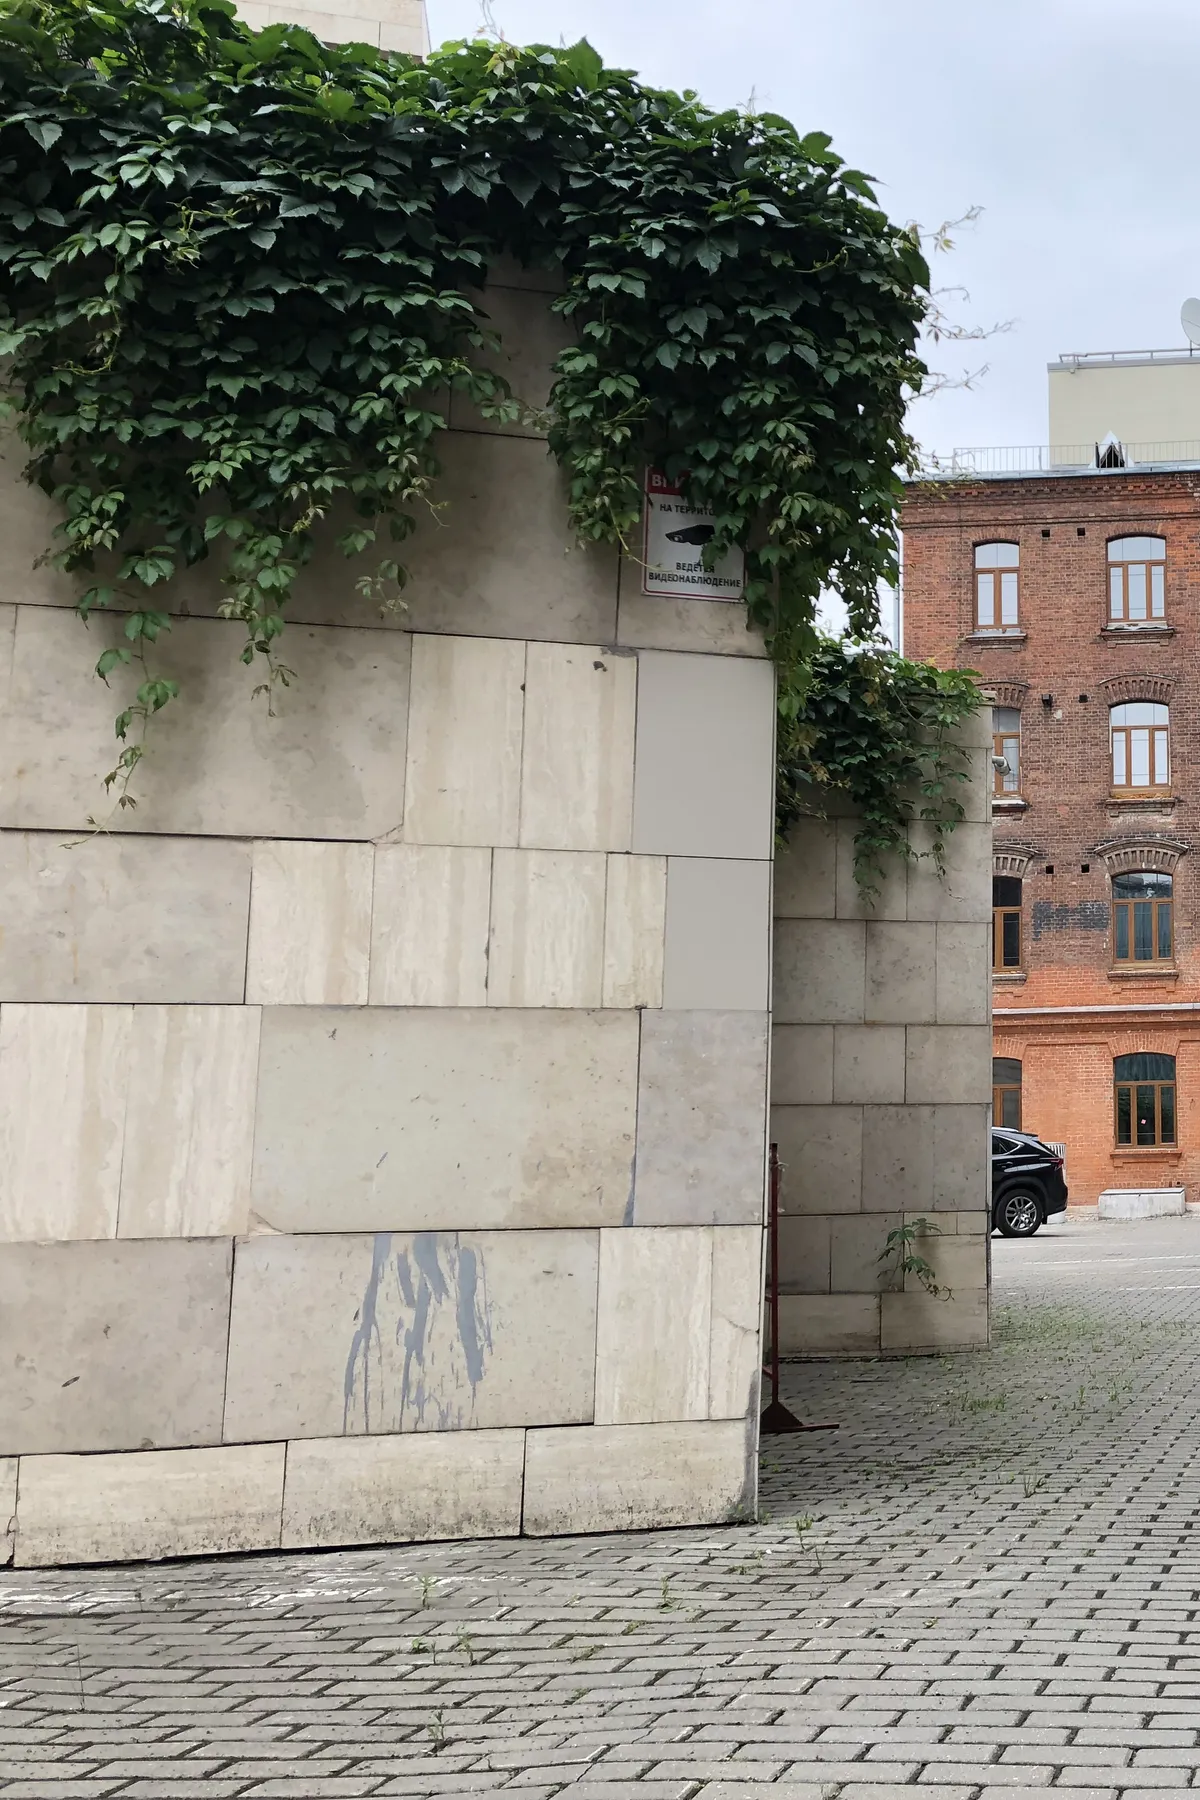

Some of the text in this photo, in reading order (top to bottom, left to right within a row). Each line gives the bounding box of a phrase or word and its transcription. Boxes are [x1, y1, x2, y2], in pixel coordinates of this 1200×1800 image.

[660, 504, 715, 516] НА ТЕРРИТО
[676, 562, 715, 573] ВЕДЕТЯ
[649, 572, 741, 587] ВИДЕОНАБЛЮДЕНИЕ
